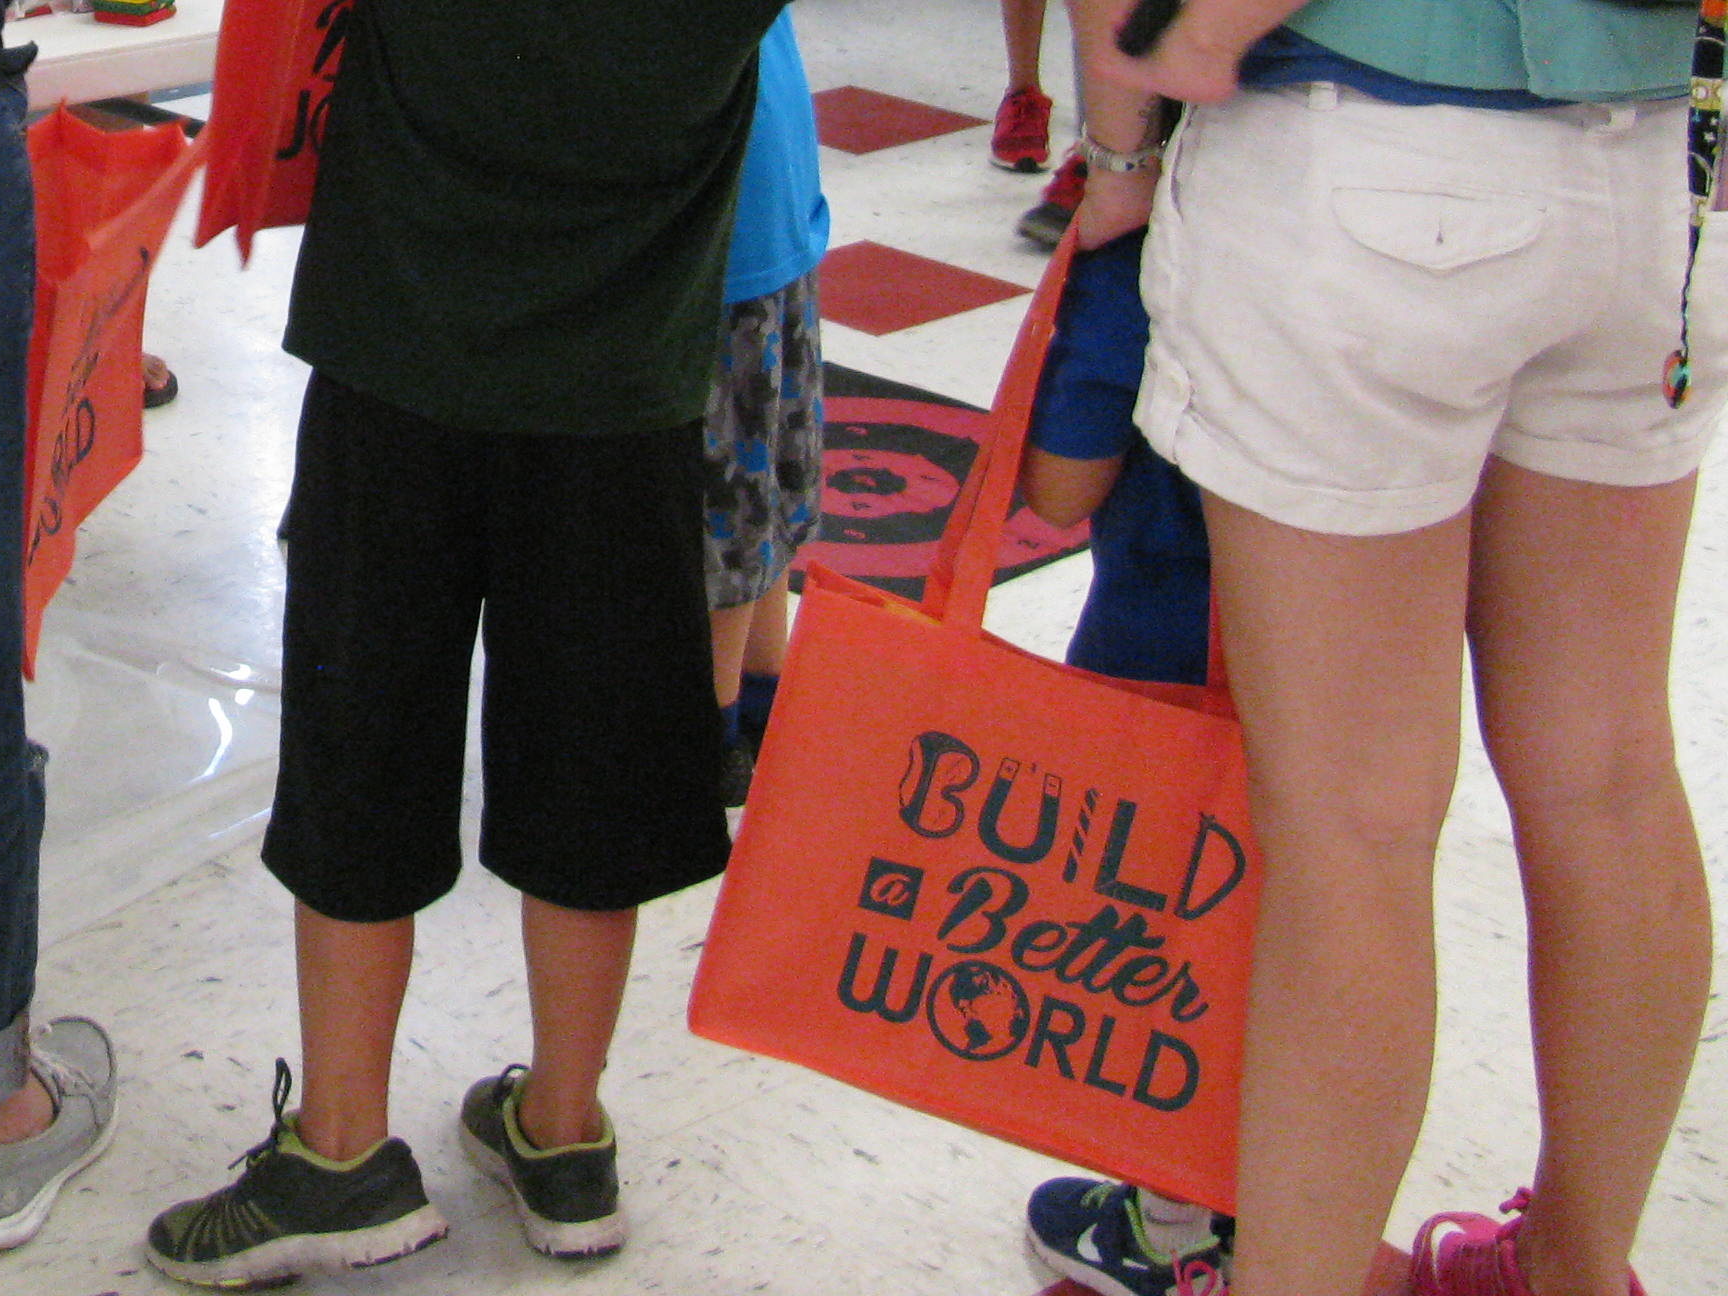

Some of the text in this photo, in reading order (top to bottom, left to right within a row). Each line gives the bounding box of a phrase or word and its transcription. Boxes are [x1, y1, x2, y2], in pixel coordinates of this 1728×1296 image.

[898, 730, 1246, 921] BUILD
[836, 931, 1201, 1112] WORLD
[936, 865, 1209, 1023] Better
